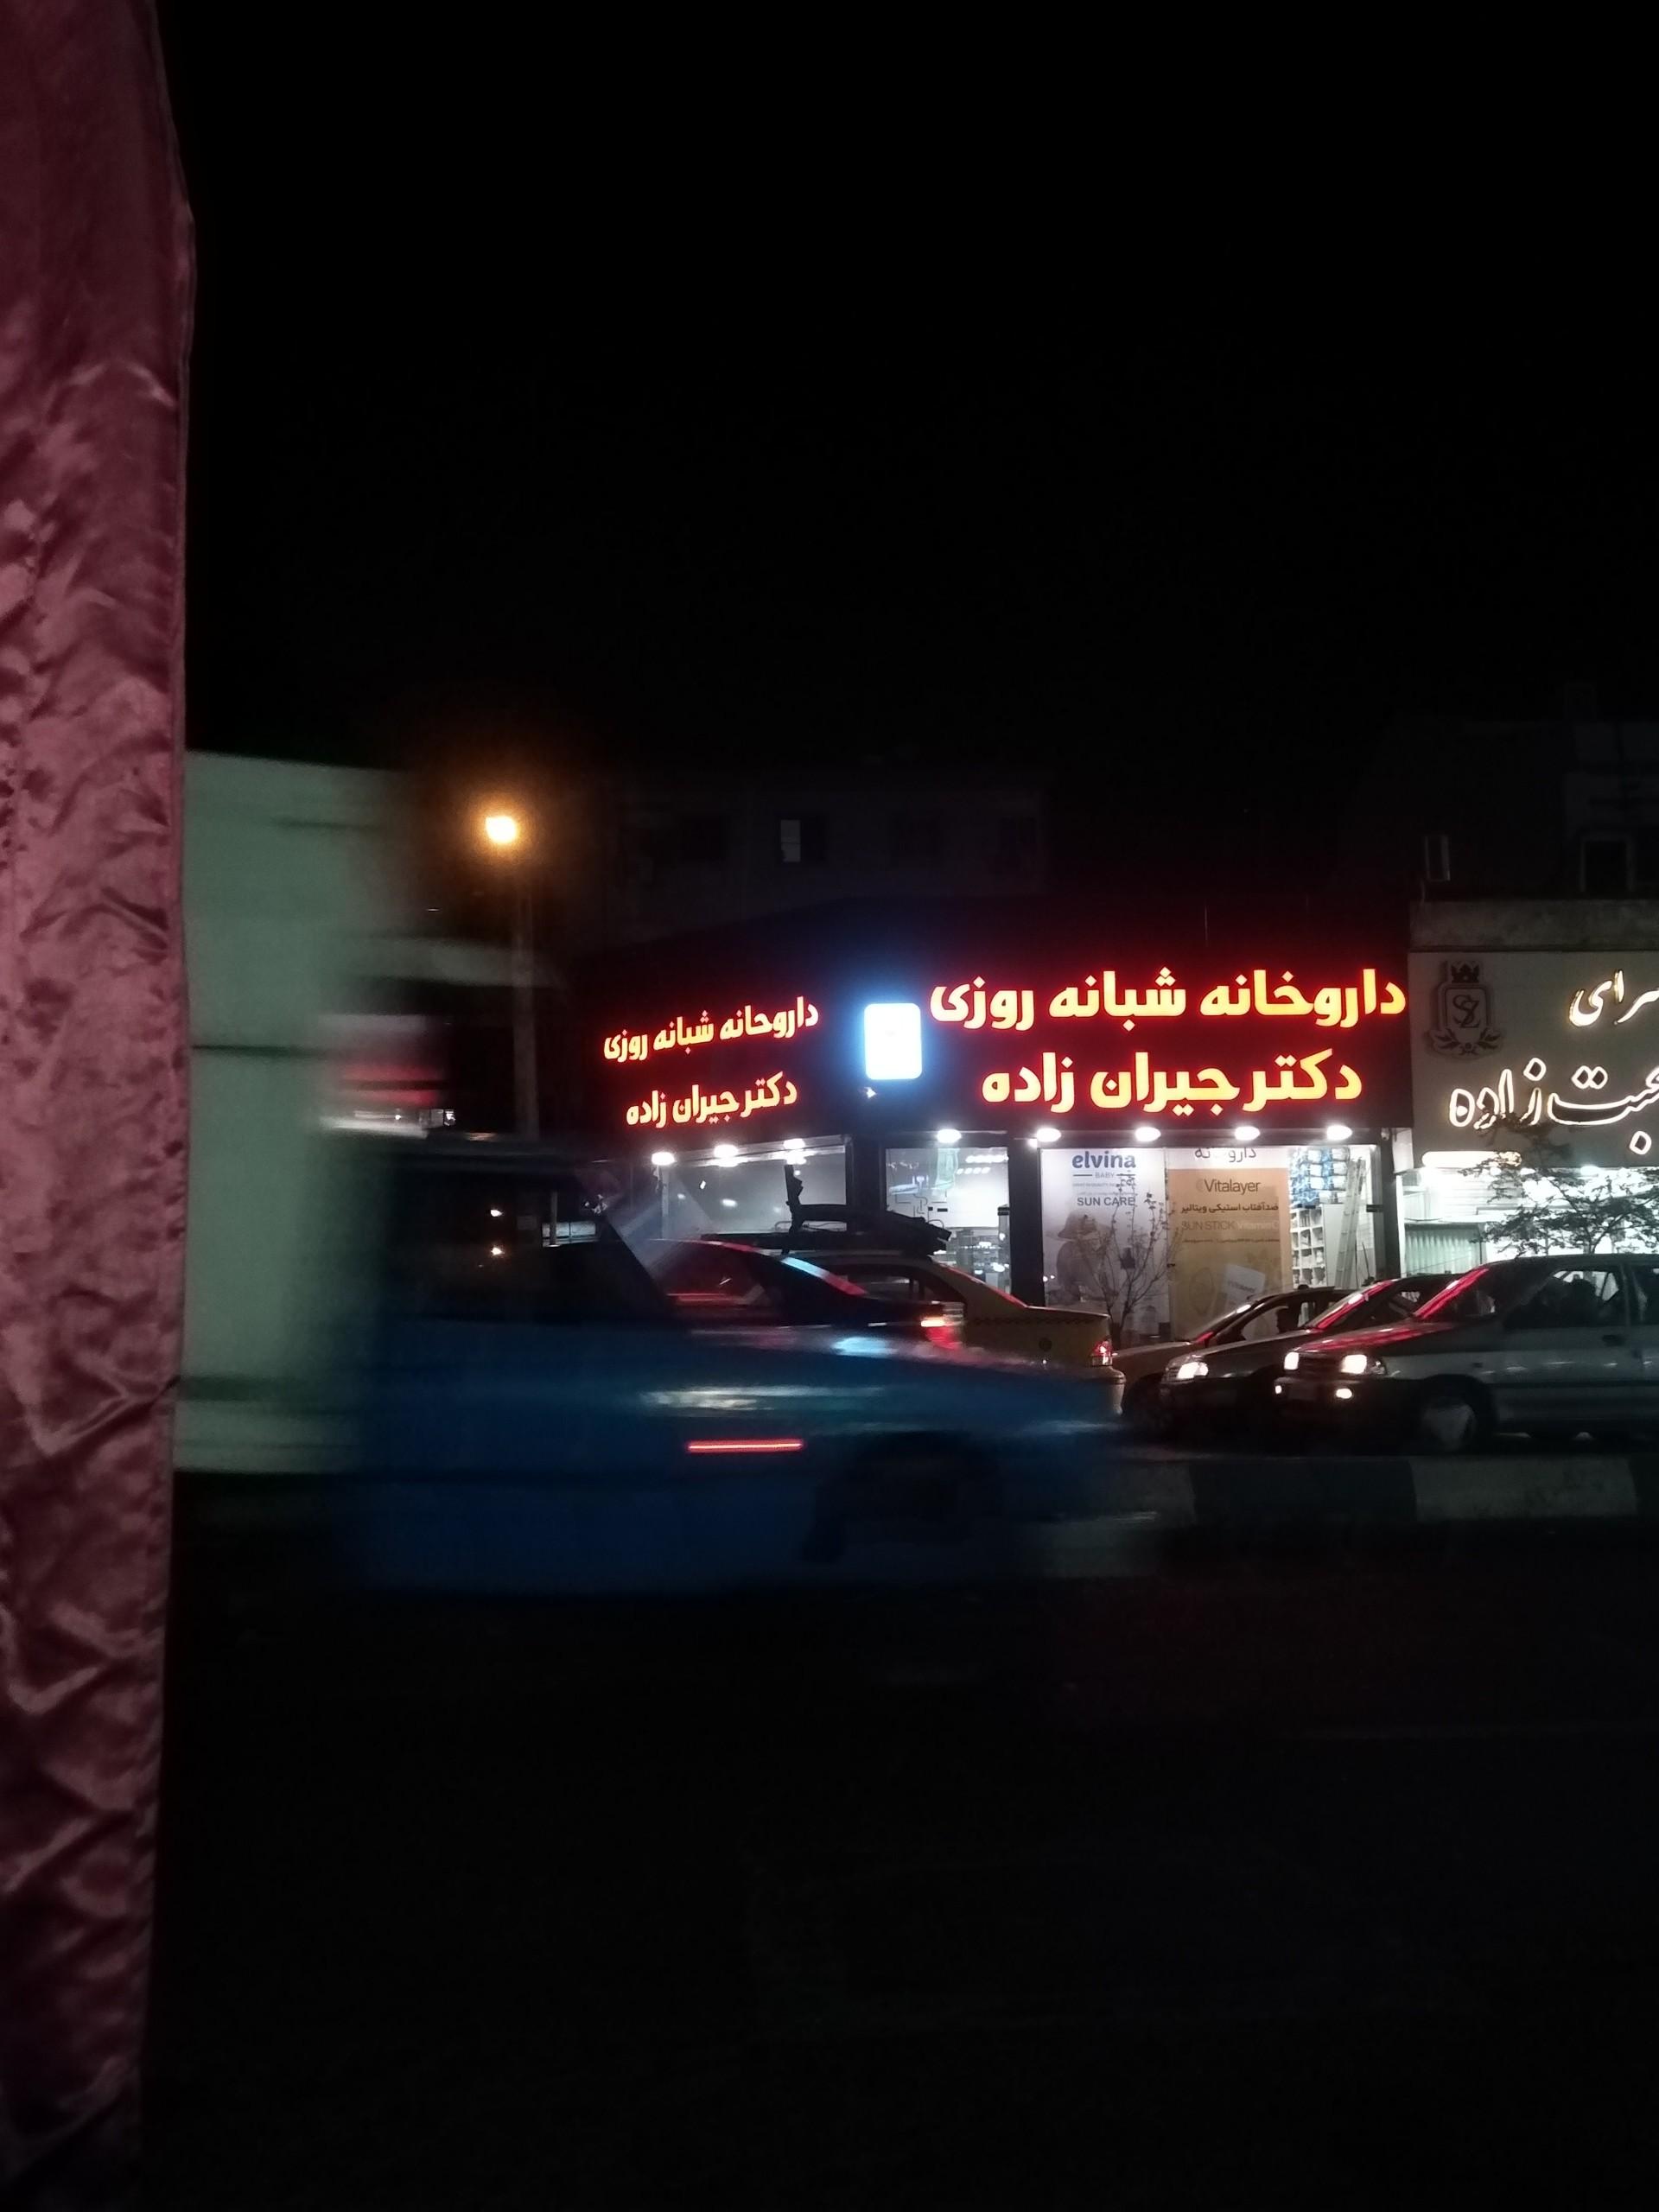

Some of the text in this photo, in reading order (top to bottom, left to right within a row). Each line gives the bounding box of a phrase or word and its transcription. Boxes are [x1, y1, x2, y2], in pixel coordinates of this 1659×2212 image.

[930, 967, 1407, 1032] داروخانه شبانه روزی
[603, 1029, 648, 1063] روزی
[653, 1010, 715, 1054] شبانه
[982, 1048, 1363, 1116] دکتر جیران زاده
[626, 1071, 798, 1128] دکتر جیران زاده
[1071, 1150, 1136, 1169] elvina
[1077, 1196, 1136, 1207] SUN CARE
[1204, 1178, 1262, 1195] Vitalayer
[1181, 1220, 1203, 1231] SUN
[1205, 1220, 1236, 1231] STICK
